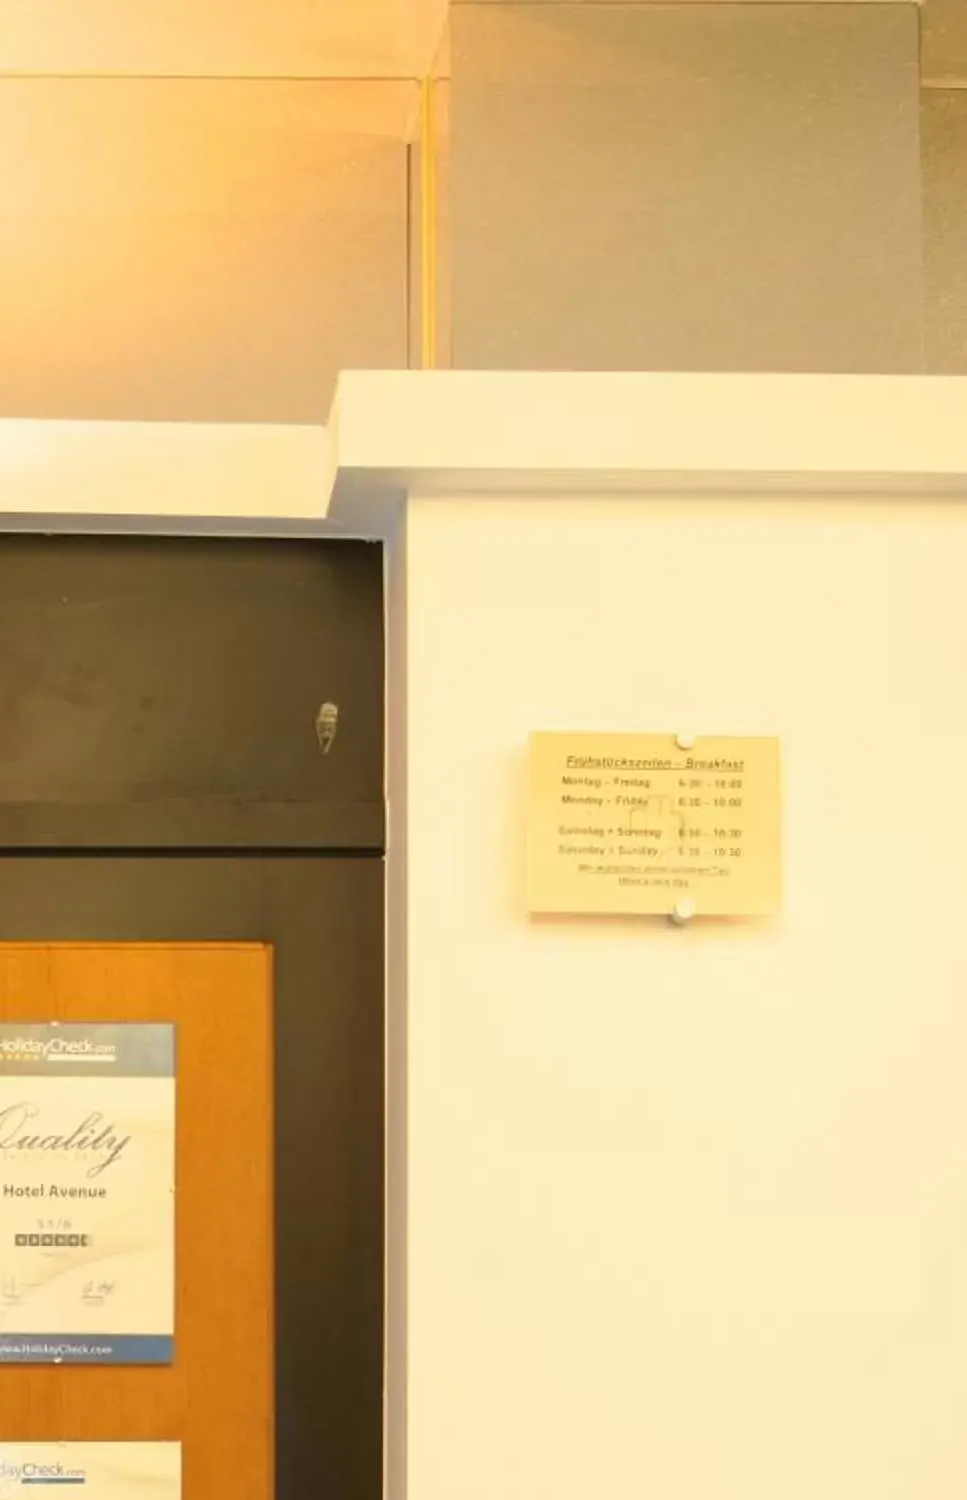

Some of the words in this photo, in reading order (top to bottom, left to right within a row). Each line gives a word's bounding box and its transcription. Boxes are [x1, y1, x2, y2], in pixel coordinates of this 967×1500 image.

[685, 757, 745, 770] Breakfast
[3, 1184, 44, 1199] Hotel
[49, 1185, 107, 1199] Avenue
